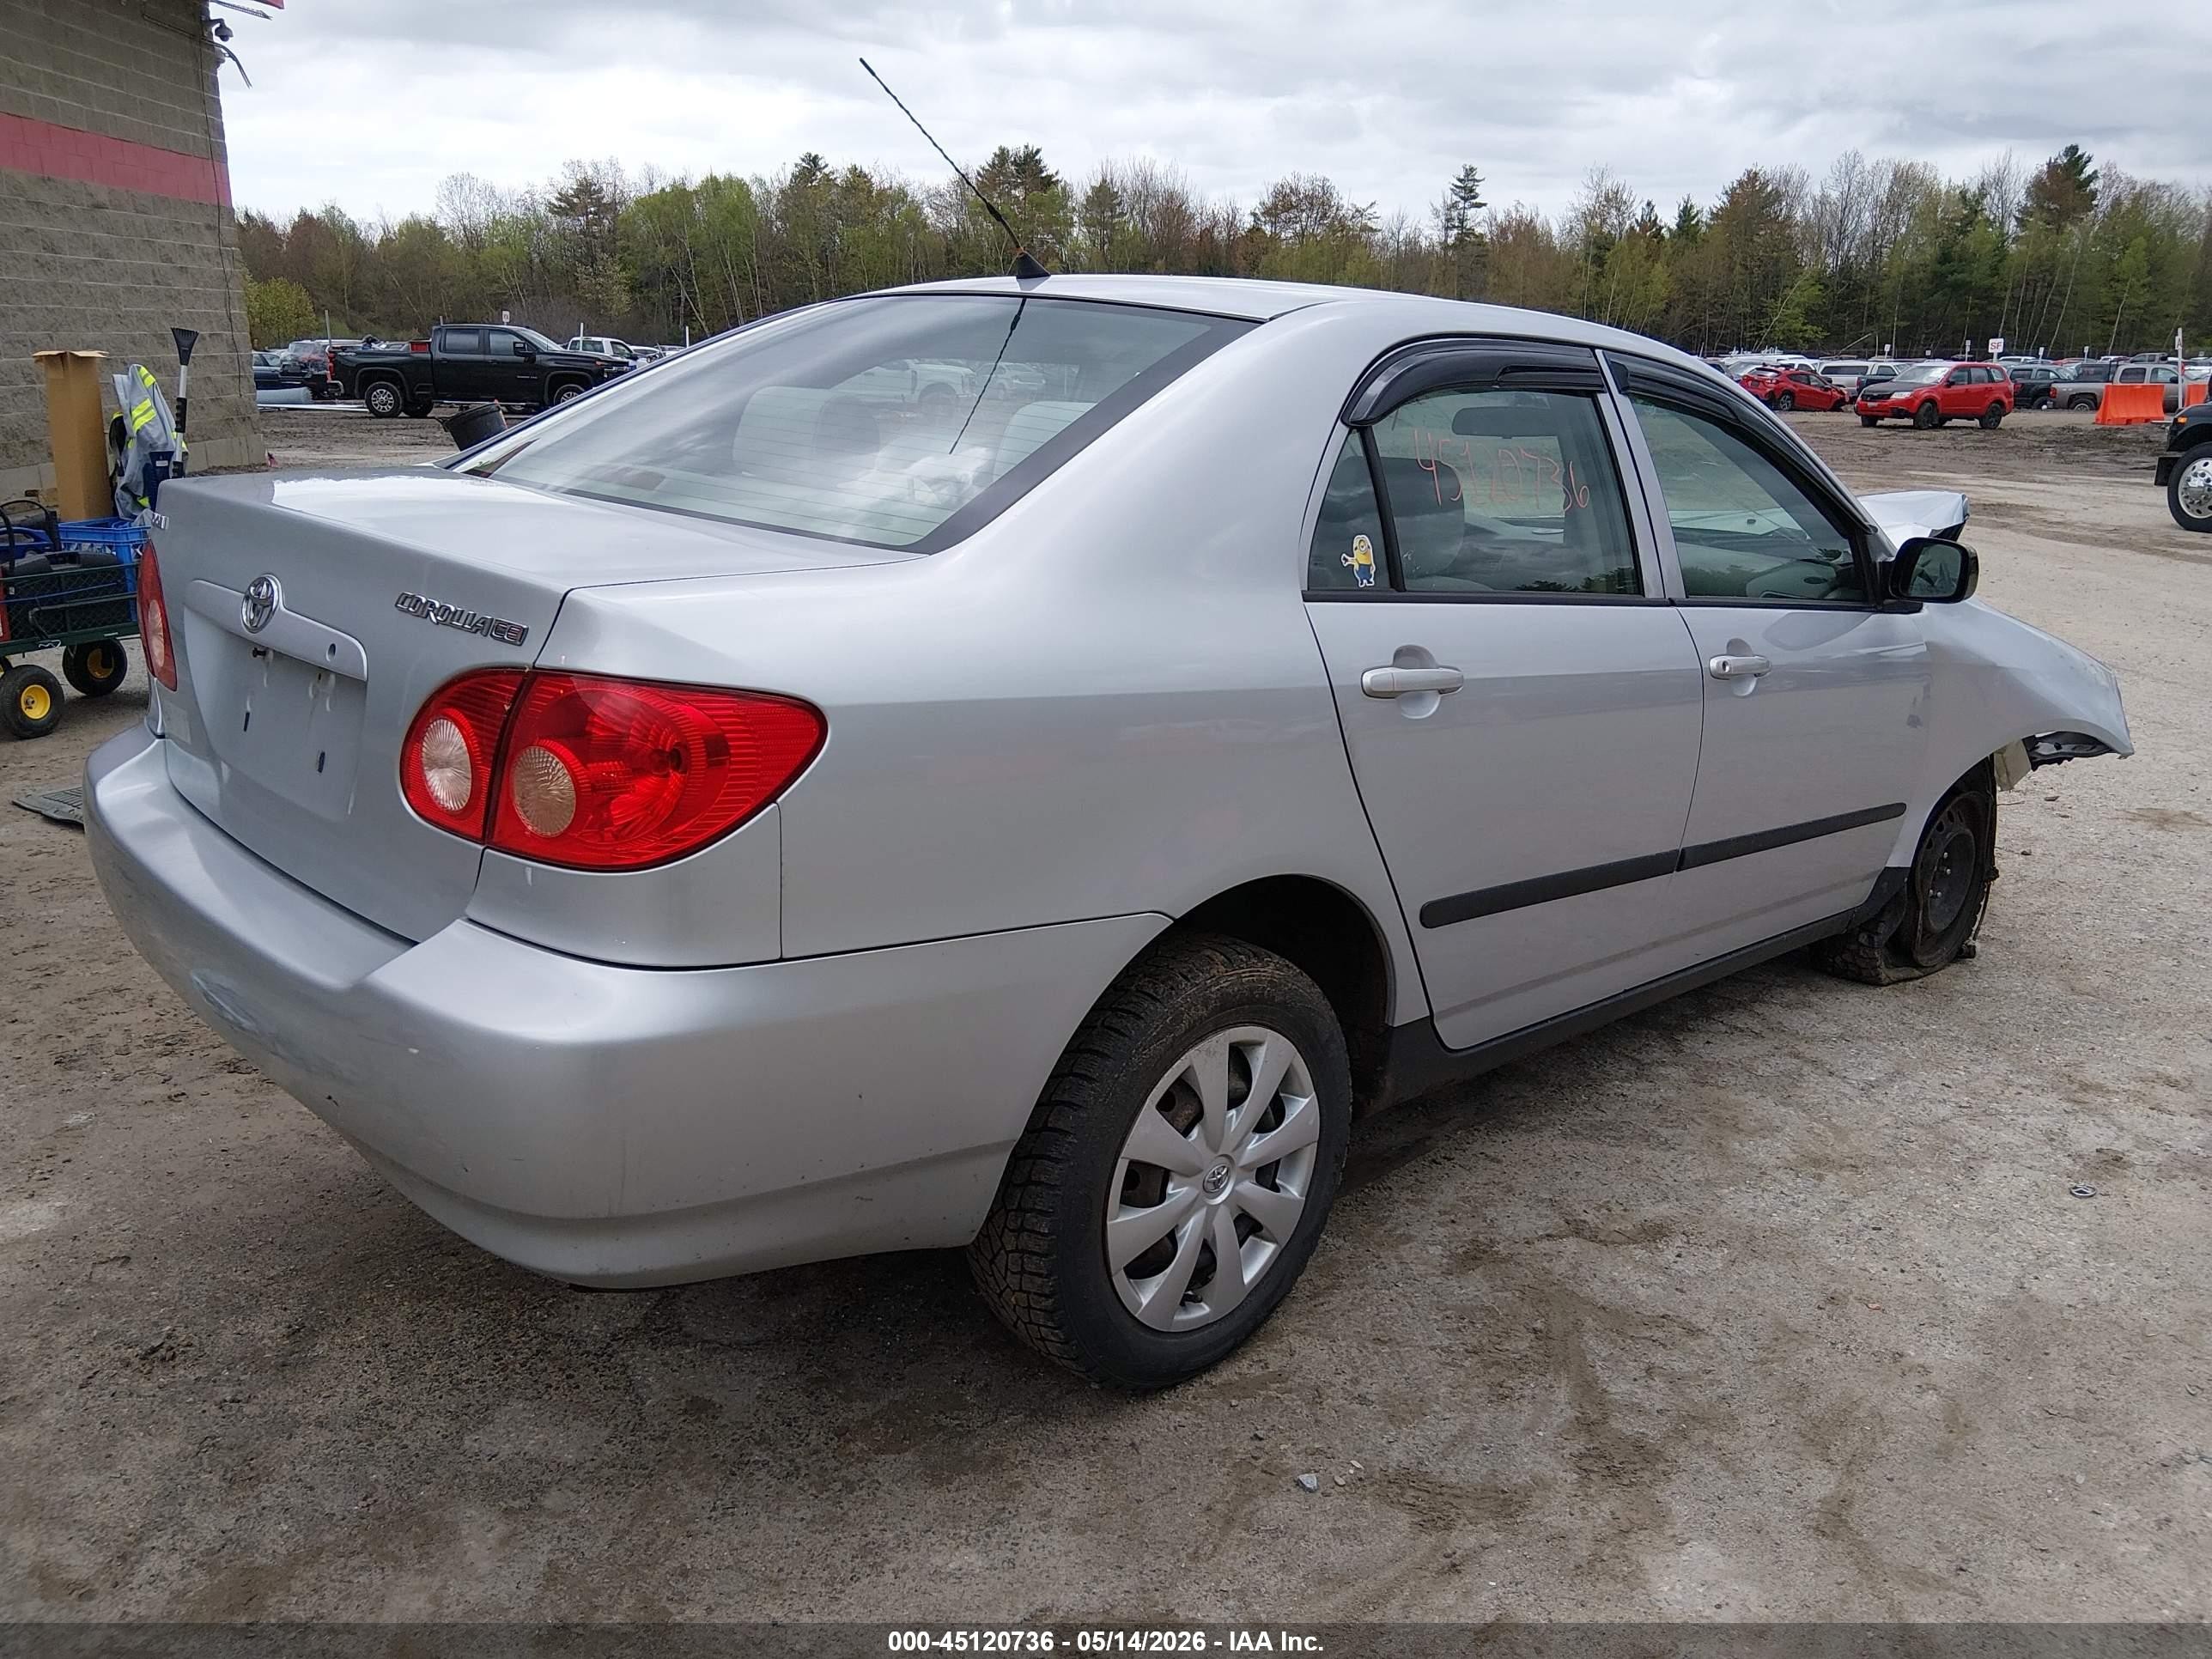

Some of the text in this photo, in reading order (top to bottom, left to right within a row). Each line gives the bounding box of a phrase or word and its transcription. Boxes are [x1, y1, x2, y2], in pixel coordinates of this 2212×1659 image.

[1414, 428, 1589, 512] 45120736
[395, 592, 529, 646] COROLLA CE
